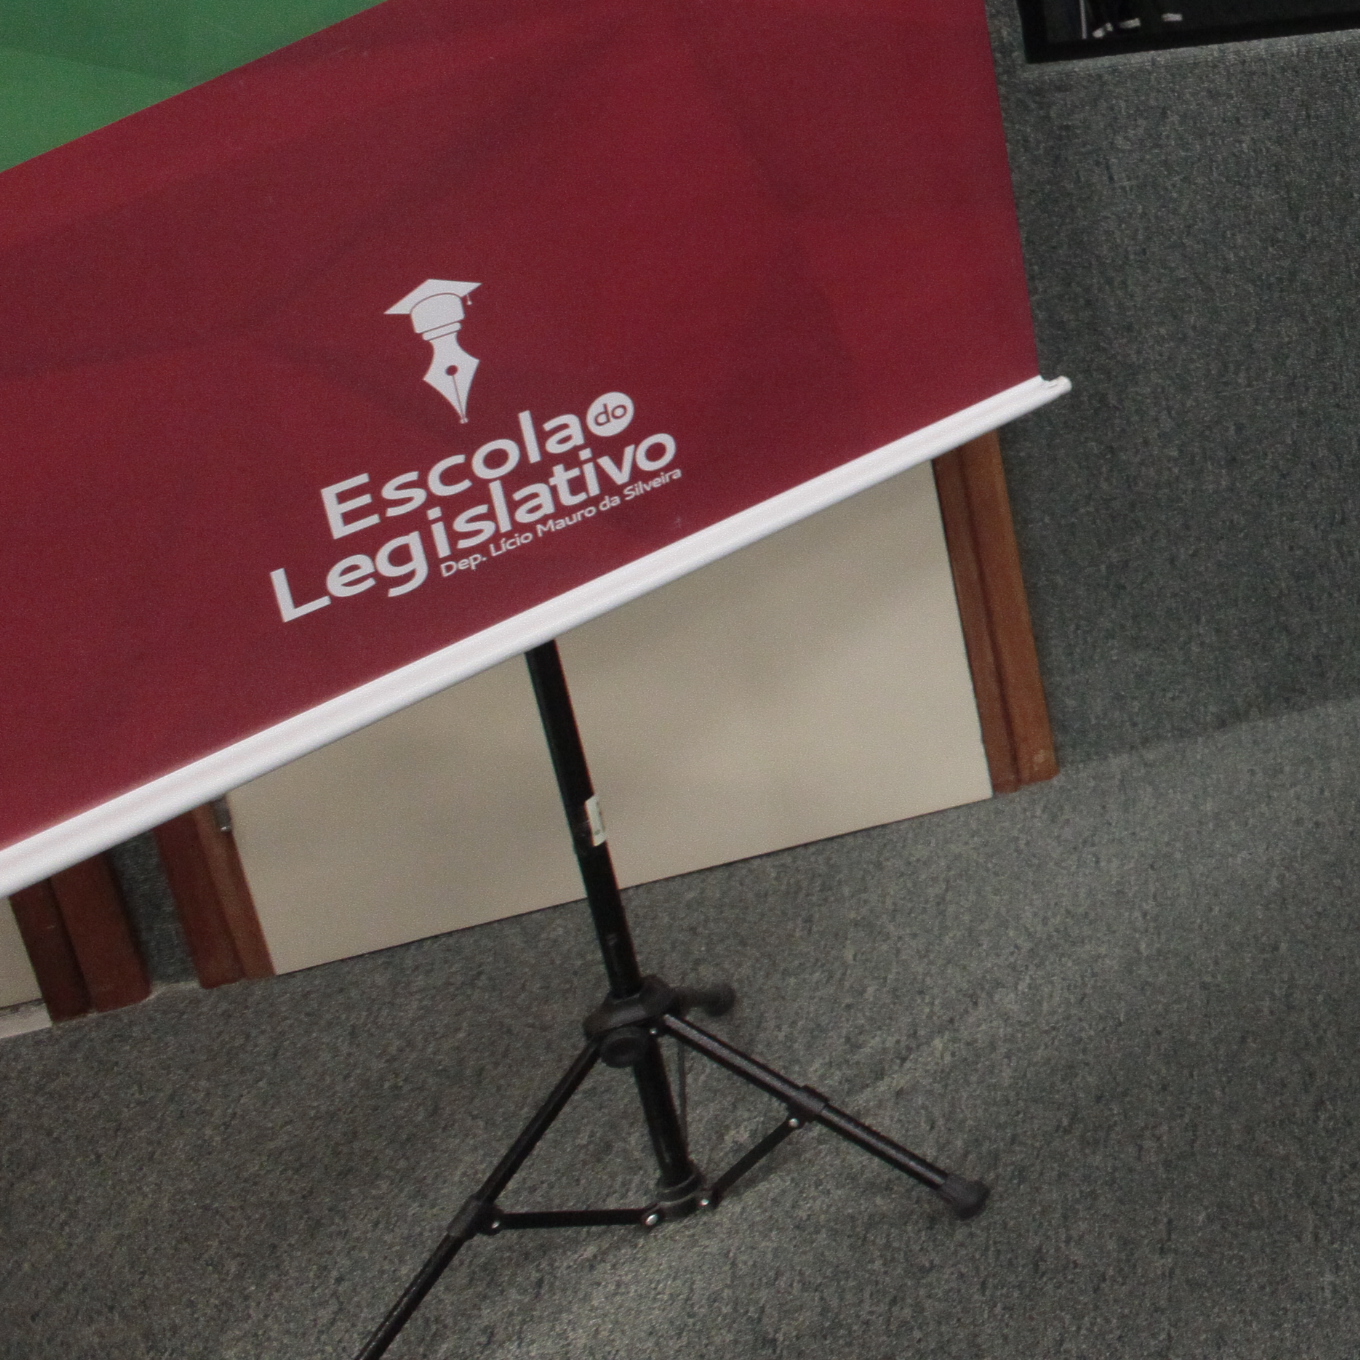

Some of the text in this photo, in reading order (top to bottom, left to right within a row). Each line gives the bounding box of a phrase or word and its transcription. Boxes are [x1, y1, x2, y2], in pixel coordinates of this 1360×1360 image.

[270, 433, 677, 623] Legislativo
[320, 402, 628, 540] Escola do
[440, 468, 683, 578] Dep. Lício Mauro da Silveira
